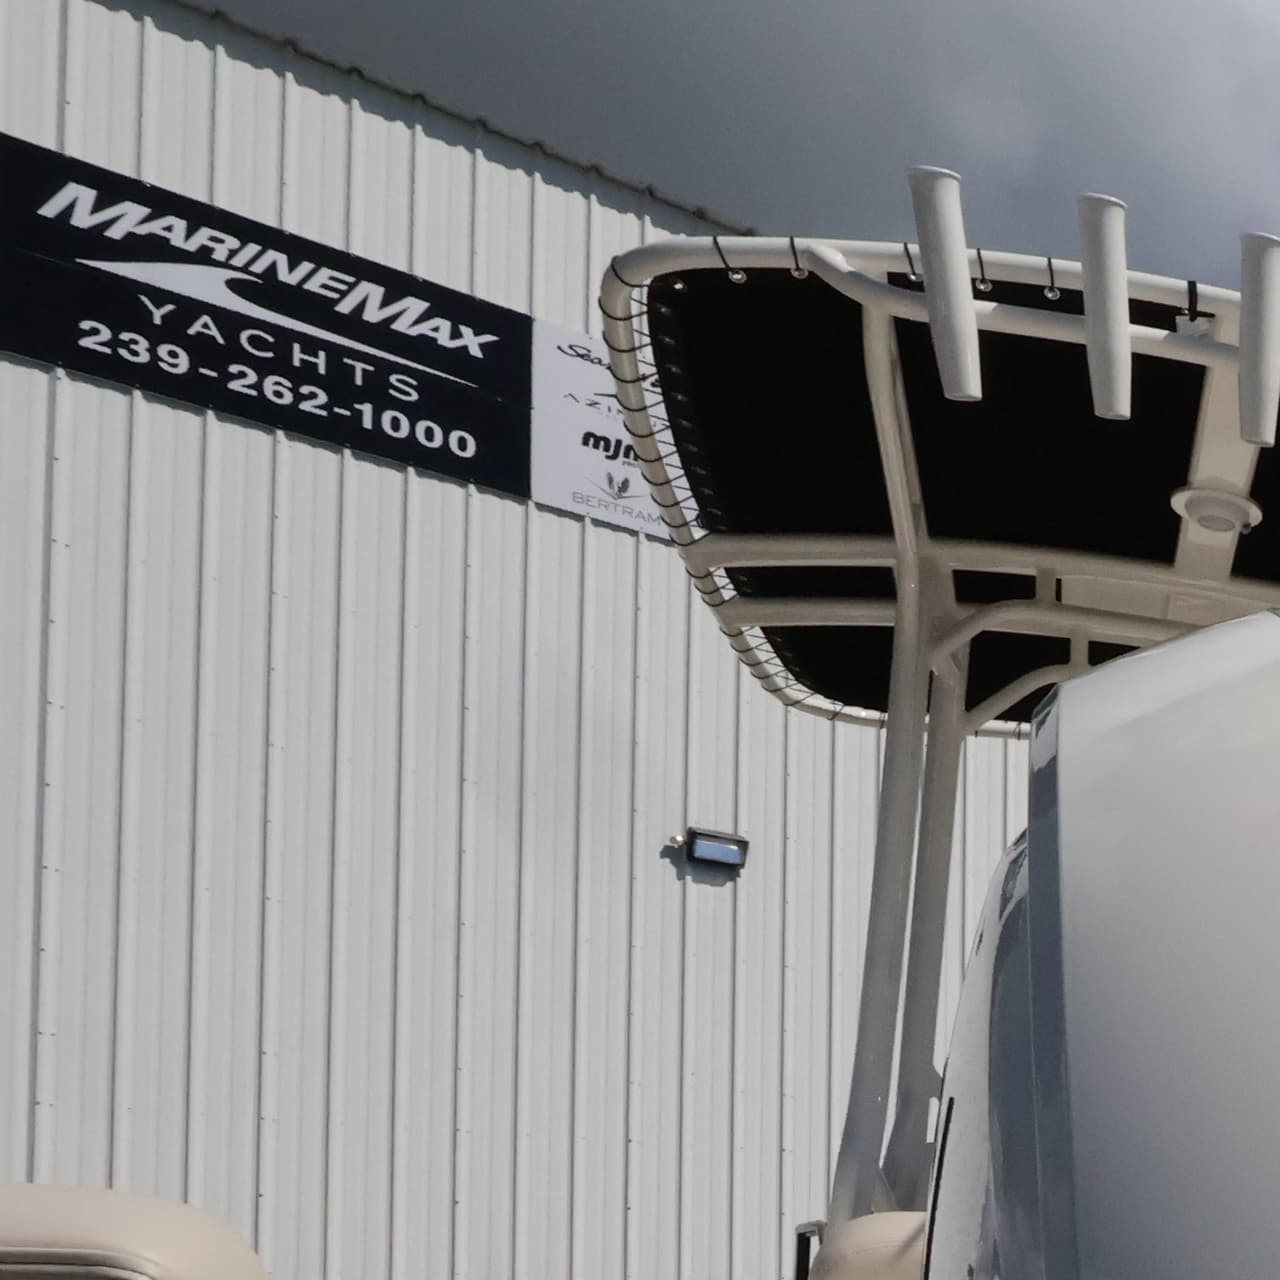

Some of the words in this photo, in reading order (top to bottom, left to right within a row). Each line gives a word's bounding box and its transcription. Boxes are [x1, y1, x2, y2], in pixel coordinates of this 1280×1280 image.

[76, 319, 478, 459] 239-262-1000
[137, 294, 421, 402] YACHTS
[572, 491, 661, 526] BERTRAM
